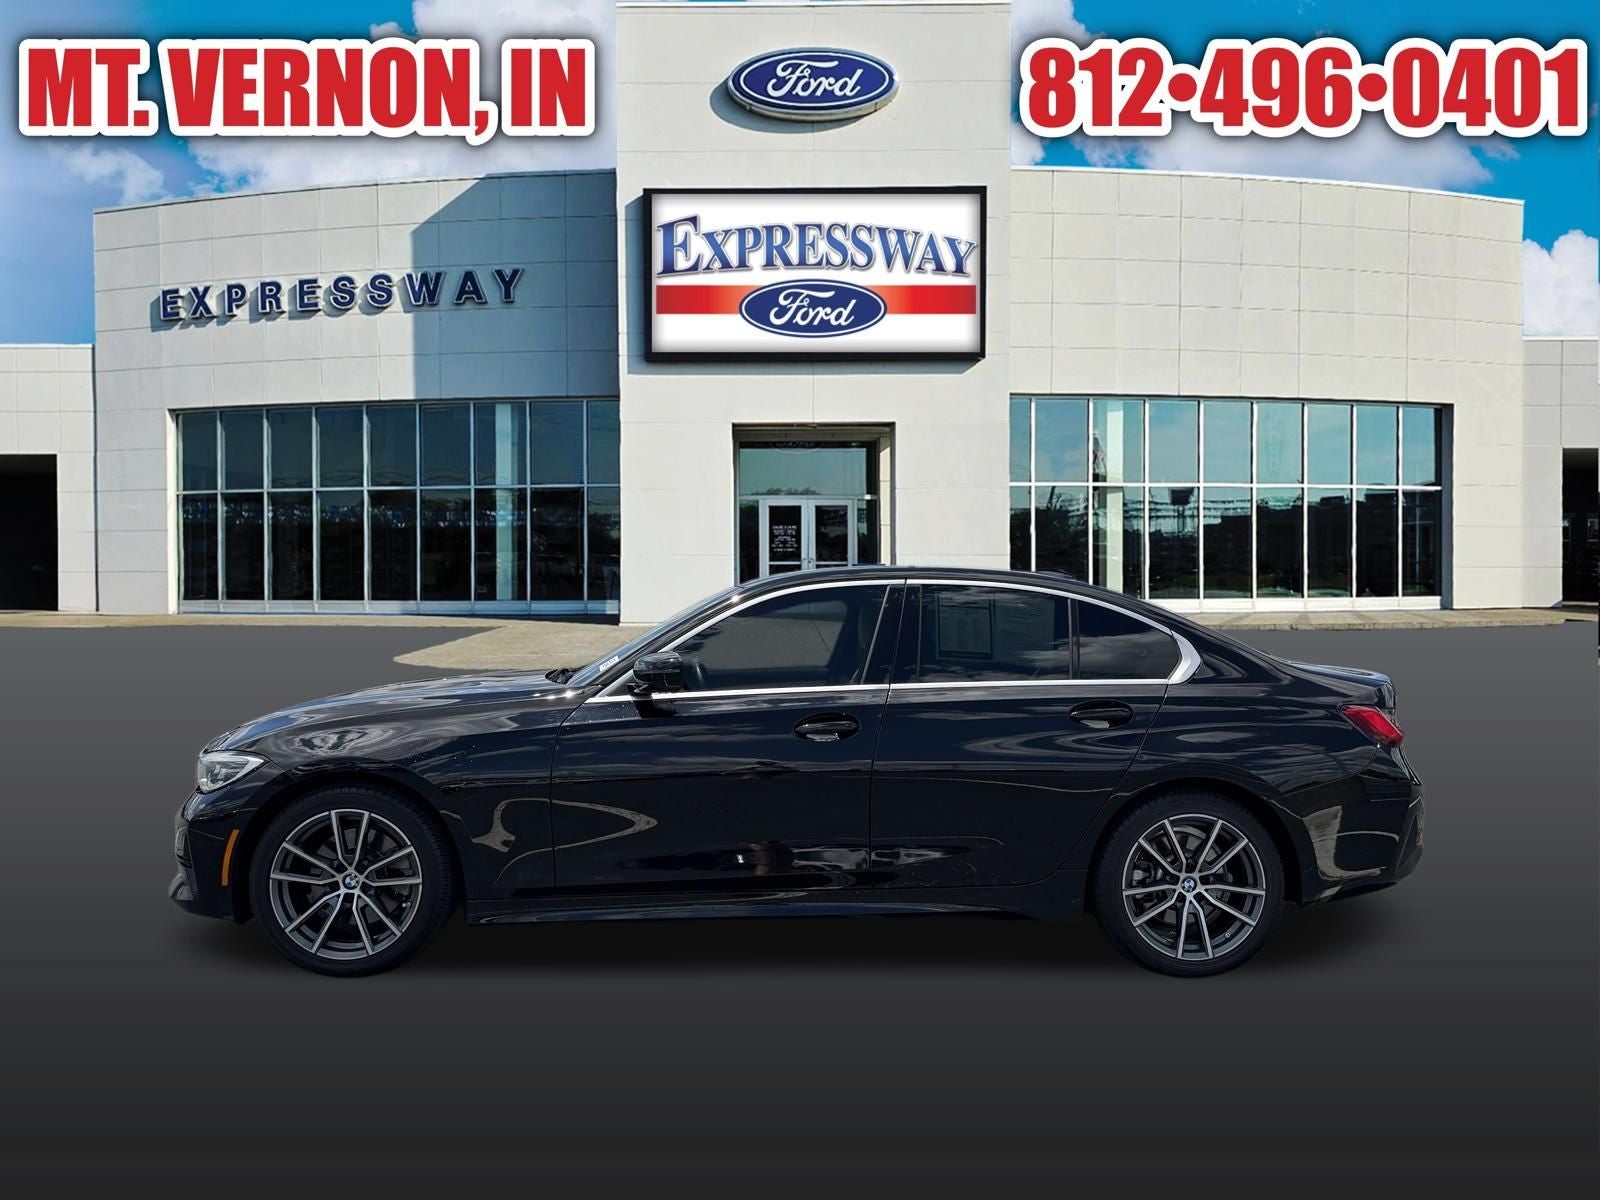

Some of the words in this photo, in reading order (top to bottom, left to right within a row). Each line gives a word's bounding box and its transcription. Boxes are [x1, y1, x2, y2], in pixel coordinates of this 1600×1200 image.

[766, 59, 864, 97] Ford
[655, 213, 978, 278] EXPRESSWAY
[160, 268, 524, 321] EXPRESSWAY
[769, 288, 856, 327] Ford
